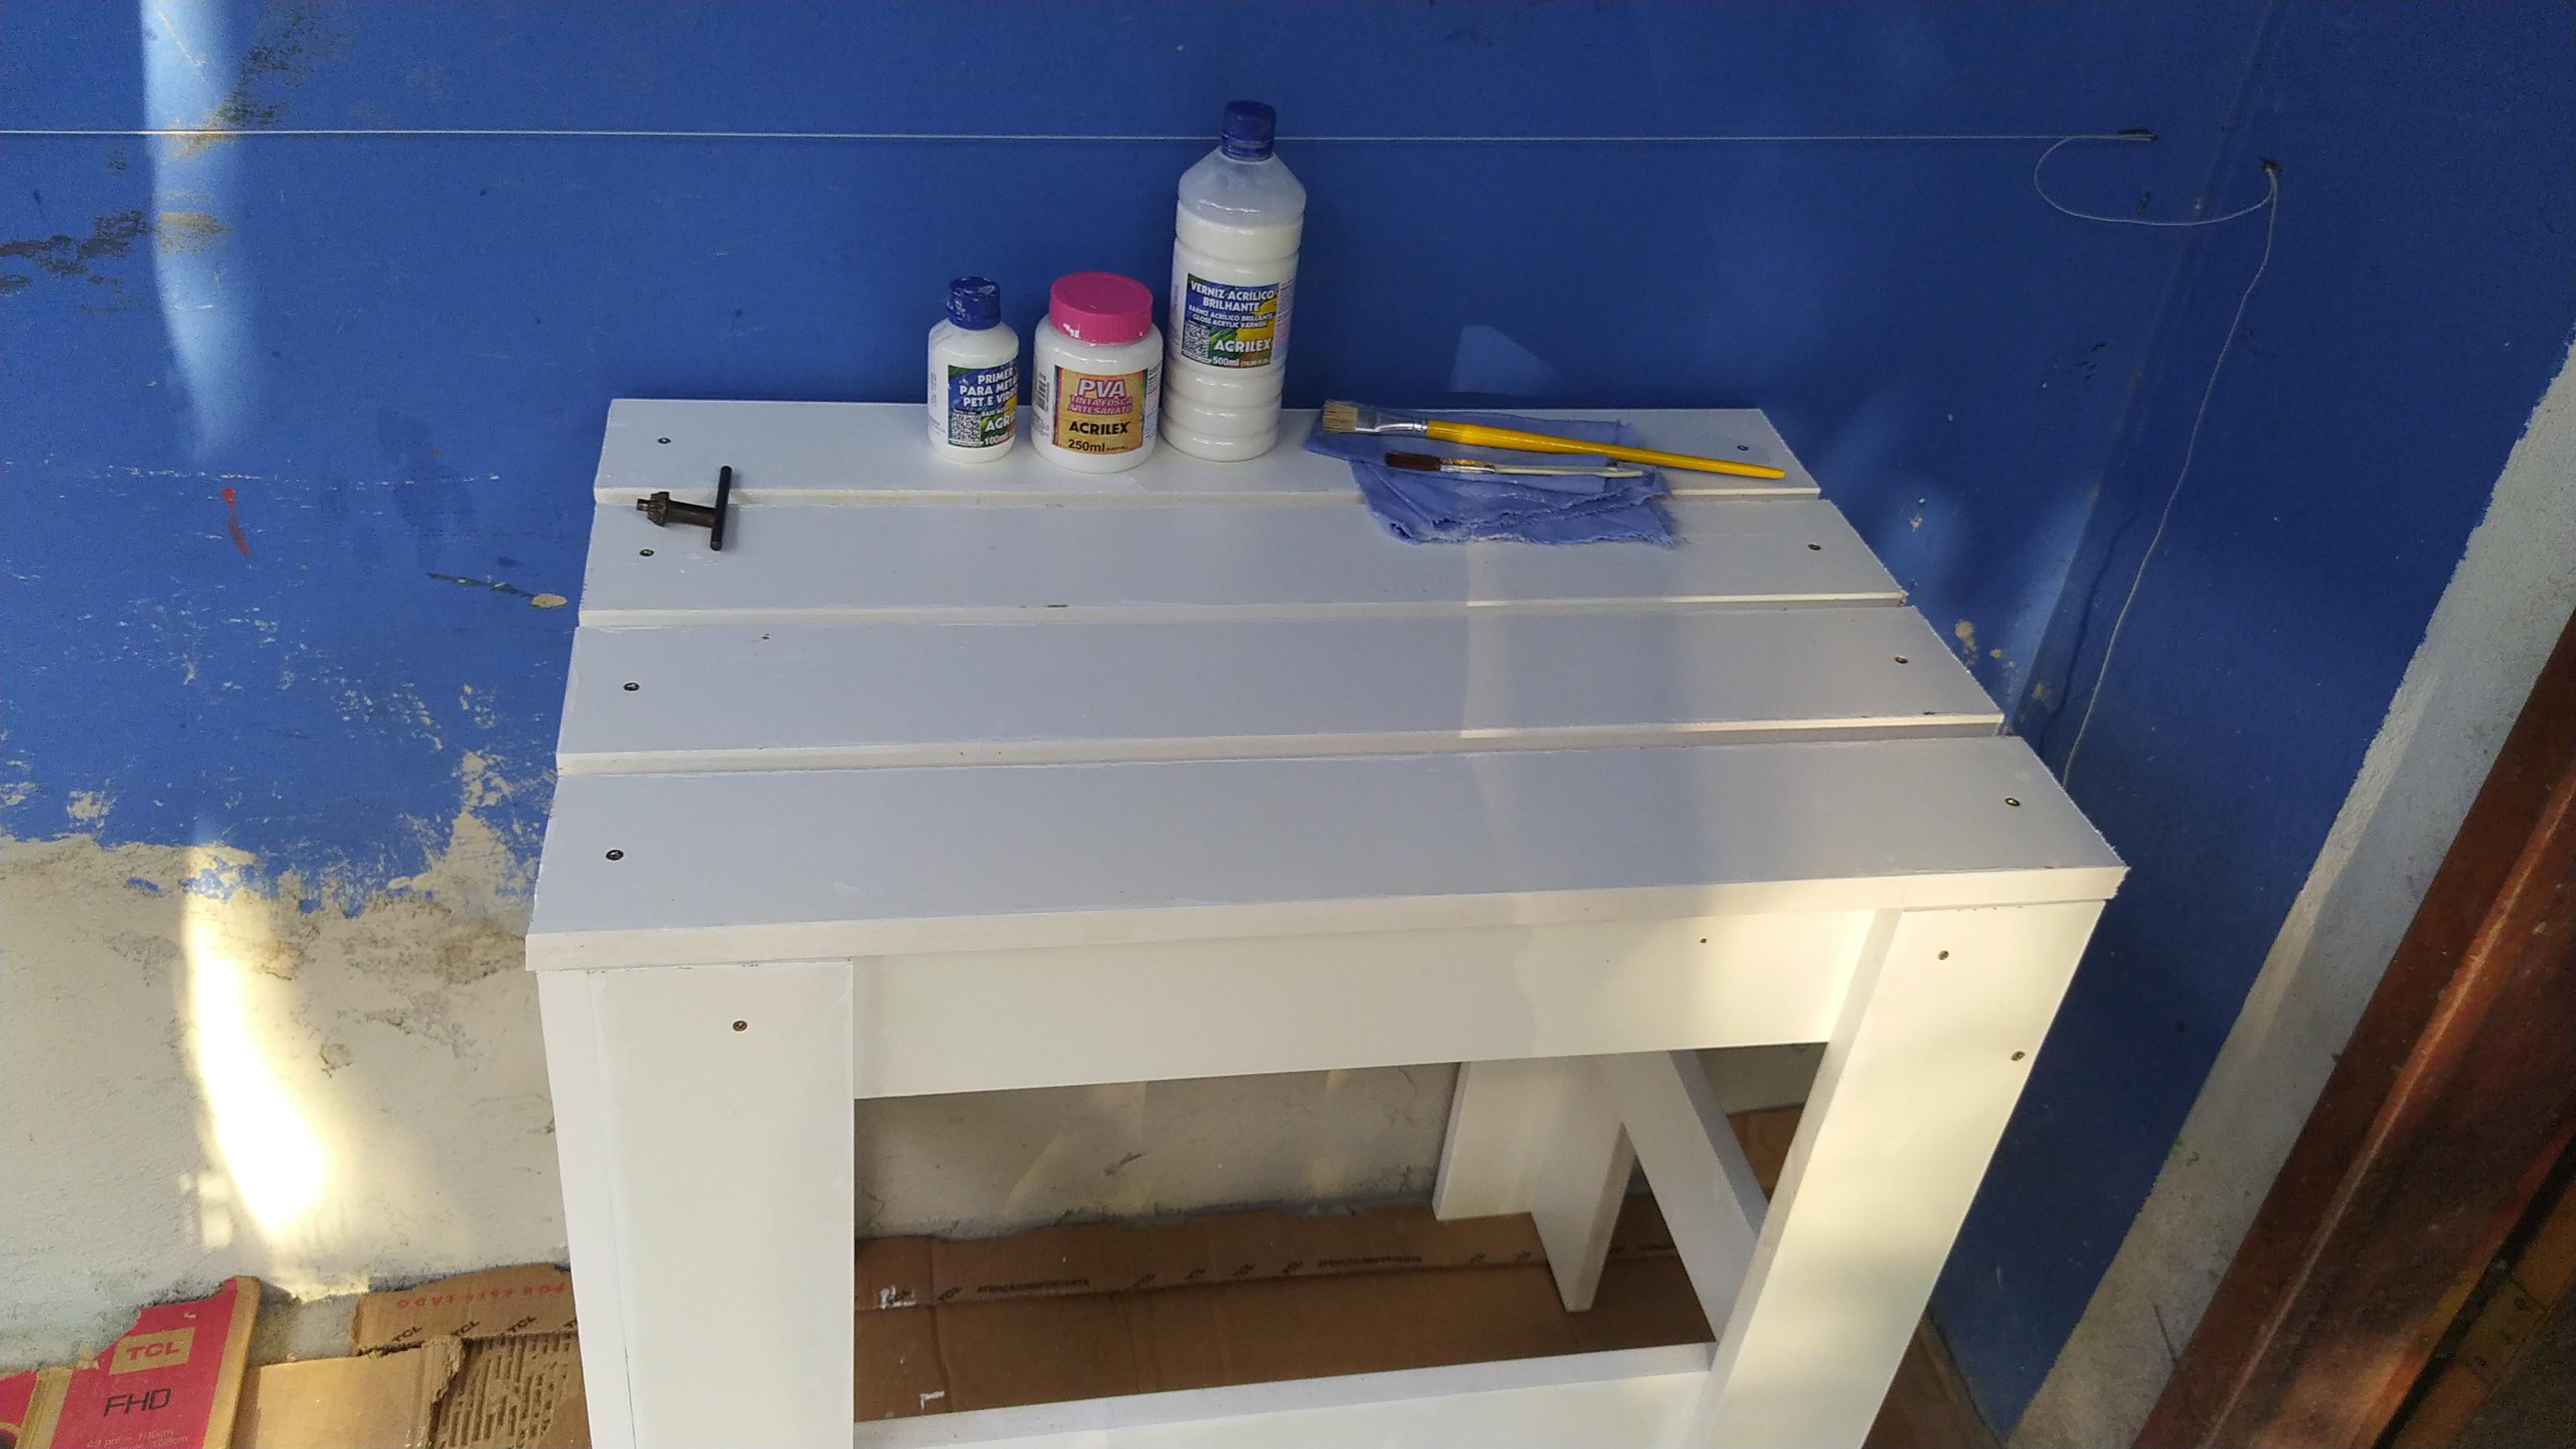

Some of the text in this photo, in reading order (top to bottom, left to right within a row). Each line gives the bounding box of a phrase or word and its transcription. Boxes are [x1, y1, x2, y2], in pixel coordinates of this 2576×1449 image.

[1191, 281, 1275, 301] VERNIZ ACRÍLICO
[1203, 297, 1260, 312] BRILHANTE
[1192, 313, 1211, 324] GLOSS
[1212, 319, 1239, 328] ACRYLIC
[1214, 339, 1271, 353] ACRILEX
[1212, 356, 1240, 366] 500ml
[977, 367, 1014, 385] PRIMER
[959, 376, 1017, 396] PARA META
[1077, 378, 1126, 398] PVA
[963, 396, 984, 407] PET
[987, 396, 994, 406] E
[1070, 395, 1132, 407] TINTA FOSCA
[1068, 404, 1132, 415] ARTESANATO
[1069, 421, 1128, 435] ACRILEX
[1069, 439, 1106, 452] 250ml
[450, 1319, 480, 1336] TCL
[506, 1315, 537, 1333] TCL
[390, 1325, 423, 1342] TCL
[126, 1341, 181, 1359] TCL
[103, 1387, 172, 1418] FHD
